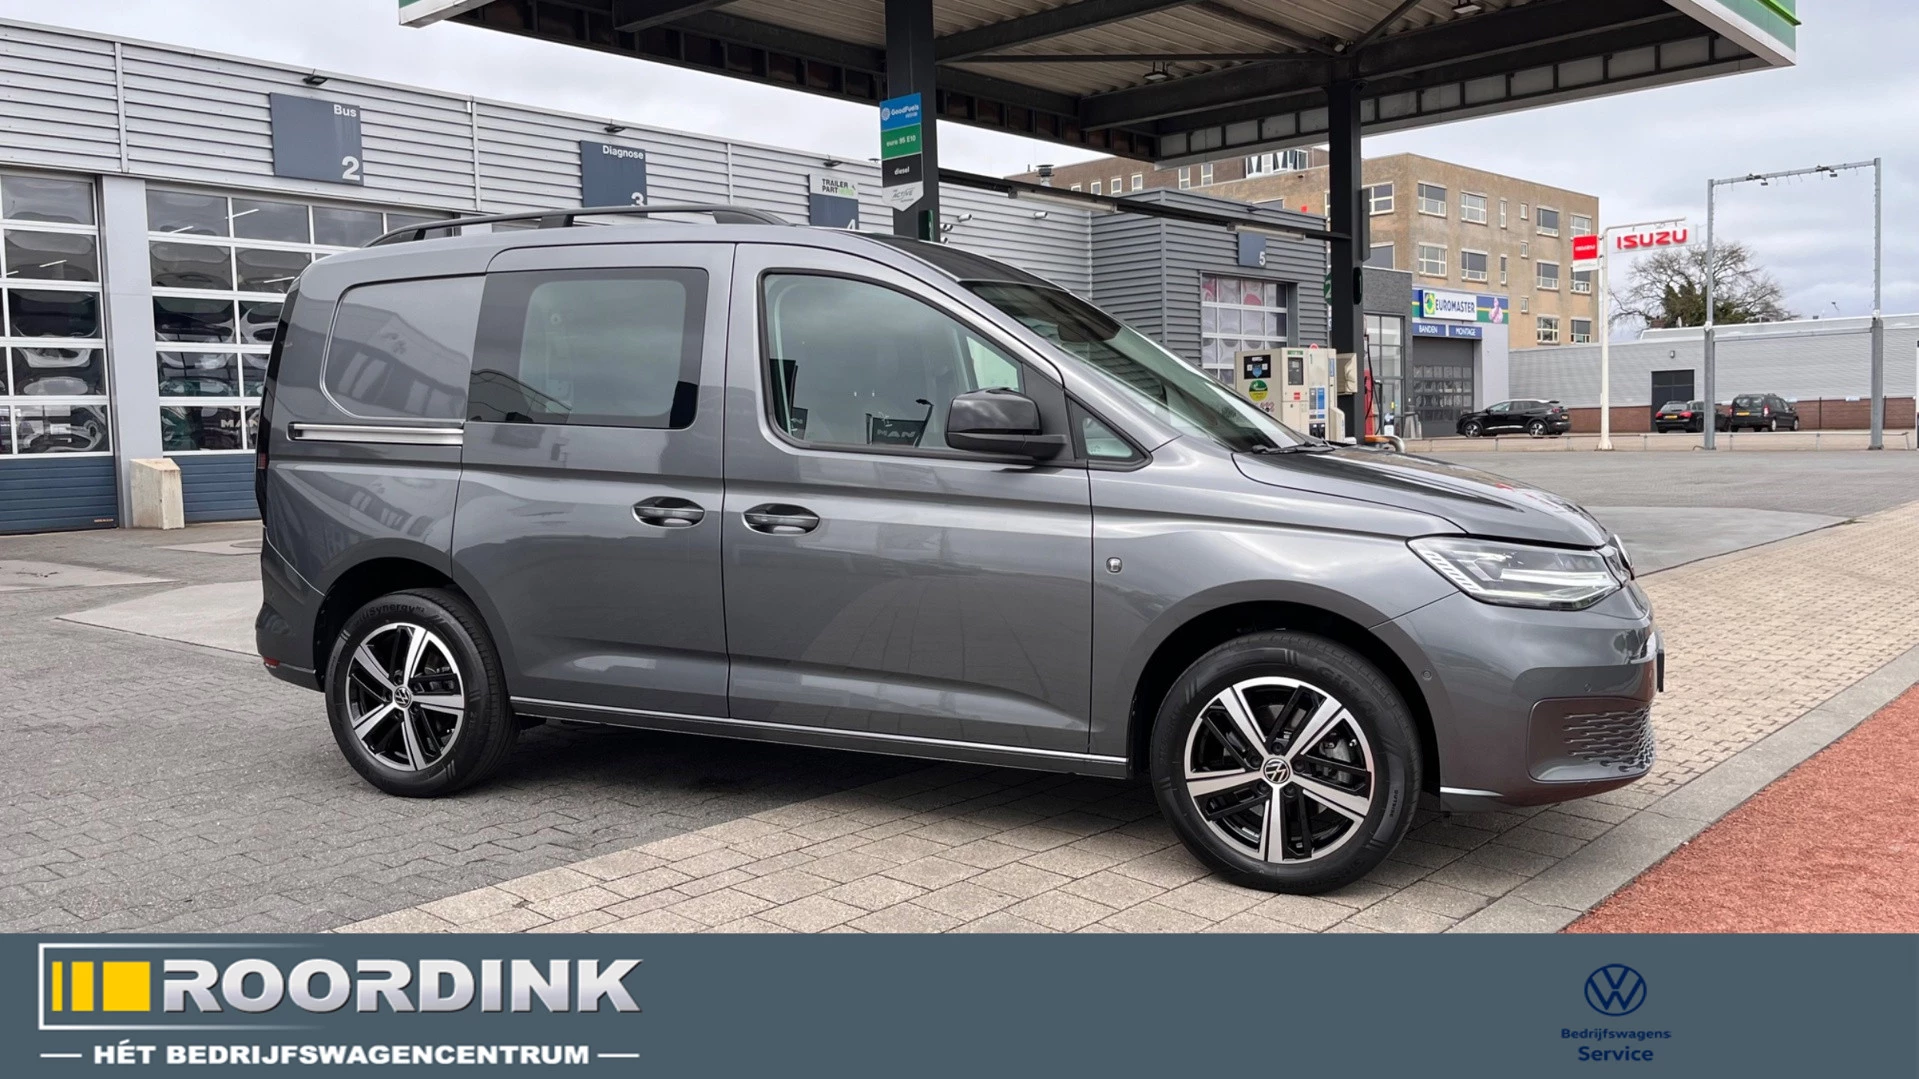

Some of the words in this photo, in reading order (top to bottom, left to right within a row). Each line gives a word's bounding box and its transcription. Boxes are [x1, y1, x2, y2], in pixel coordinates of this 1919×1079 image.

[333, 104, 357, 118] Bus
[891, 104, 920, 116] GoodFuels
[907, 135, 917, 143] E10
[602, 144, 645, 161] Diagnose
[342, 156, 361, 182] 2
[894, 166, 910, 176] diesel
[822, 178, 849, 189] TRAILER
[1616, 228, 1688, 250] ISUZU
[1258, 250, 1267, 267] 5
[1435, 298, 1476, 314] EUROMASTER
[1418, 324, 1438, 334] BANDEN
[1455, 327, 1476, 337] MONTAGE
